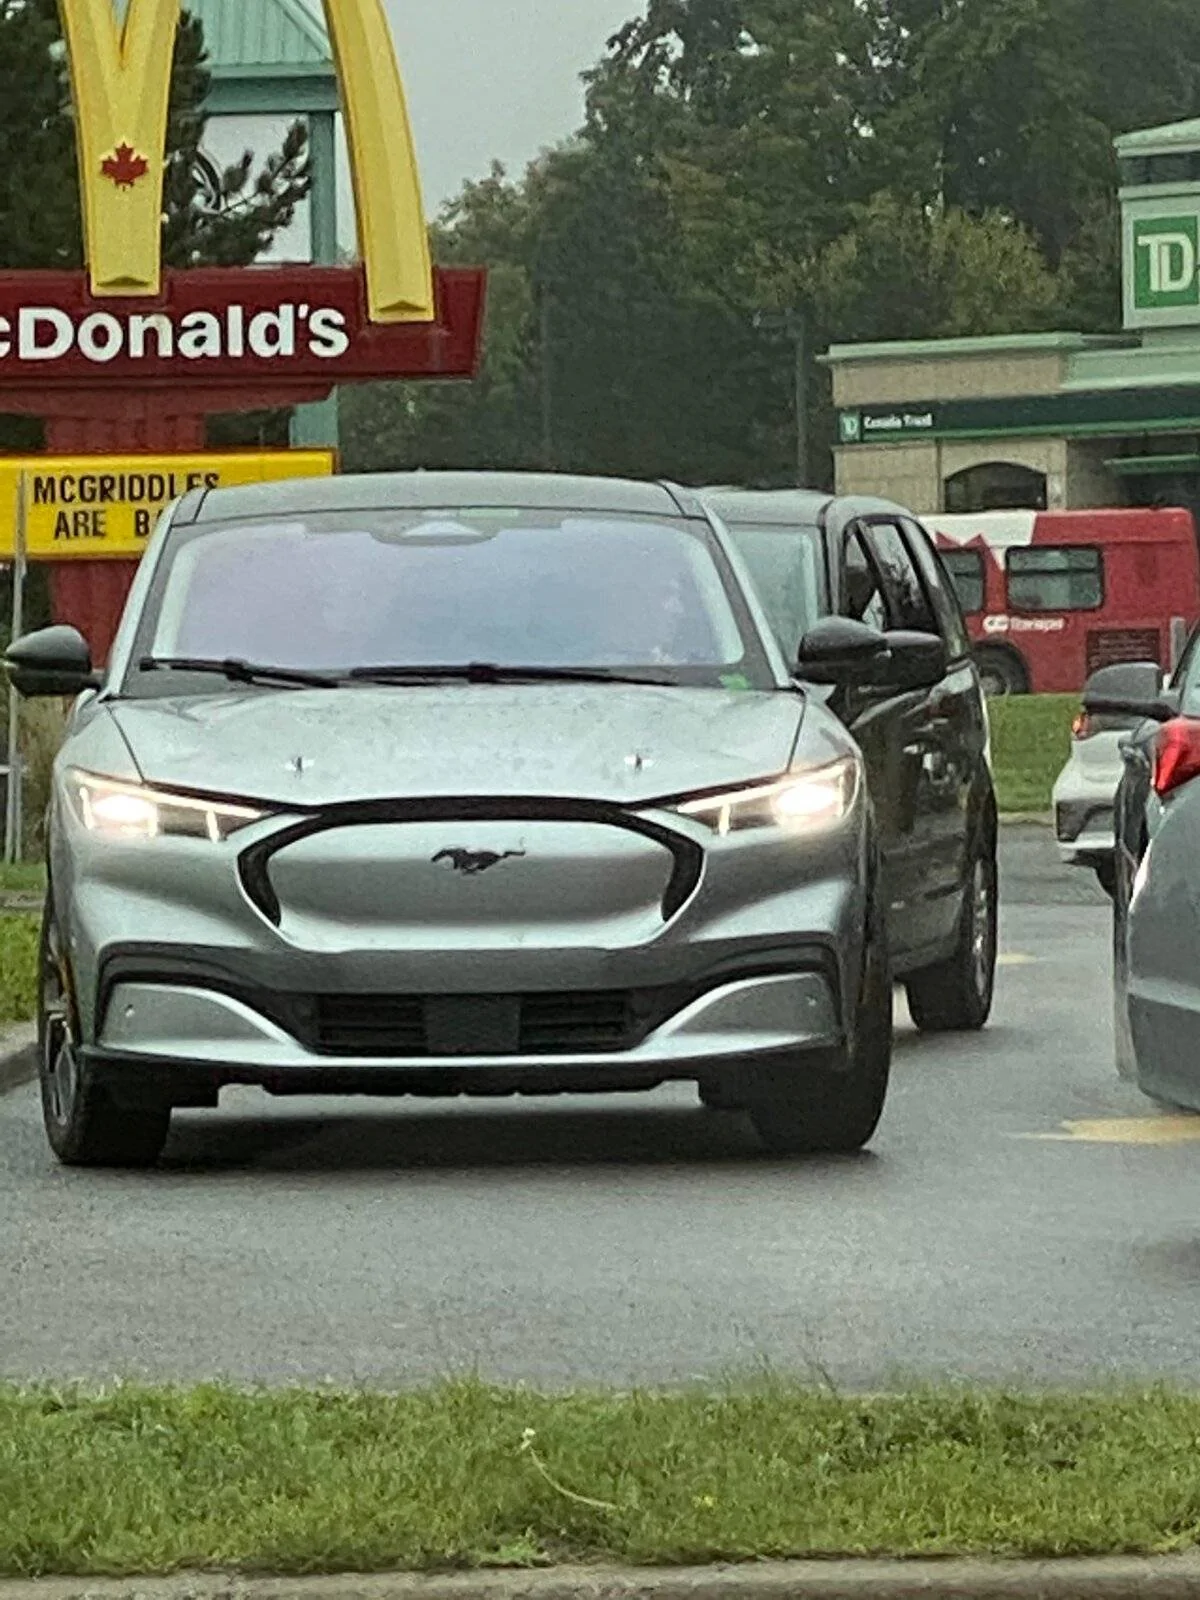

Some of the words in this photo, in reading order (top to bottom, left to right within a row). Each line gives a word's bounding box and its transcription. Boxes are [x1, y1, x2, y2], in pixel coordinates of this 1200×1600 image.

[1138, 232, 1194, 292] TD
[0, 305, 349, 361] Donald's
[54, 509, 106, 540] ARE
